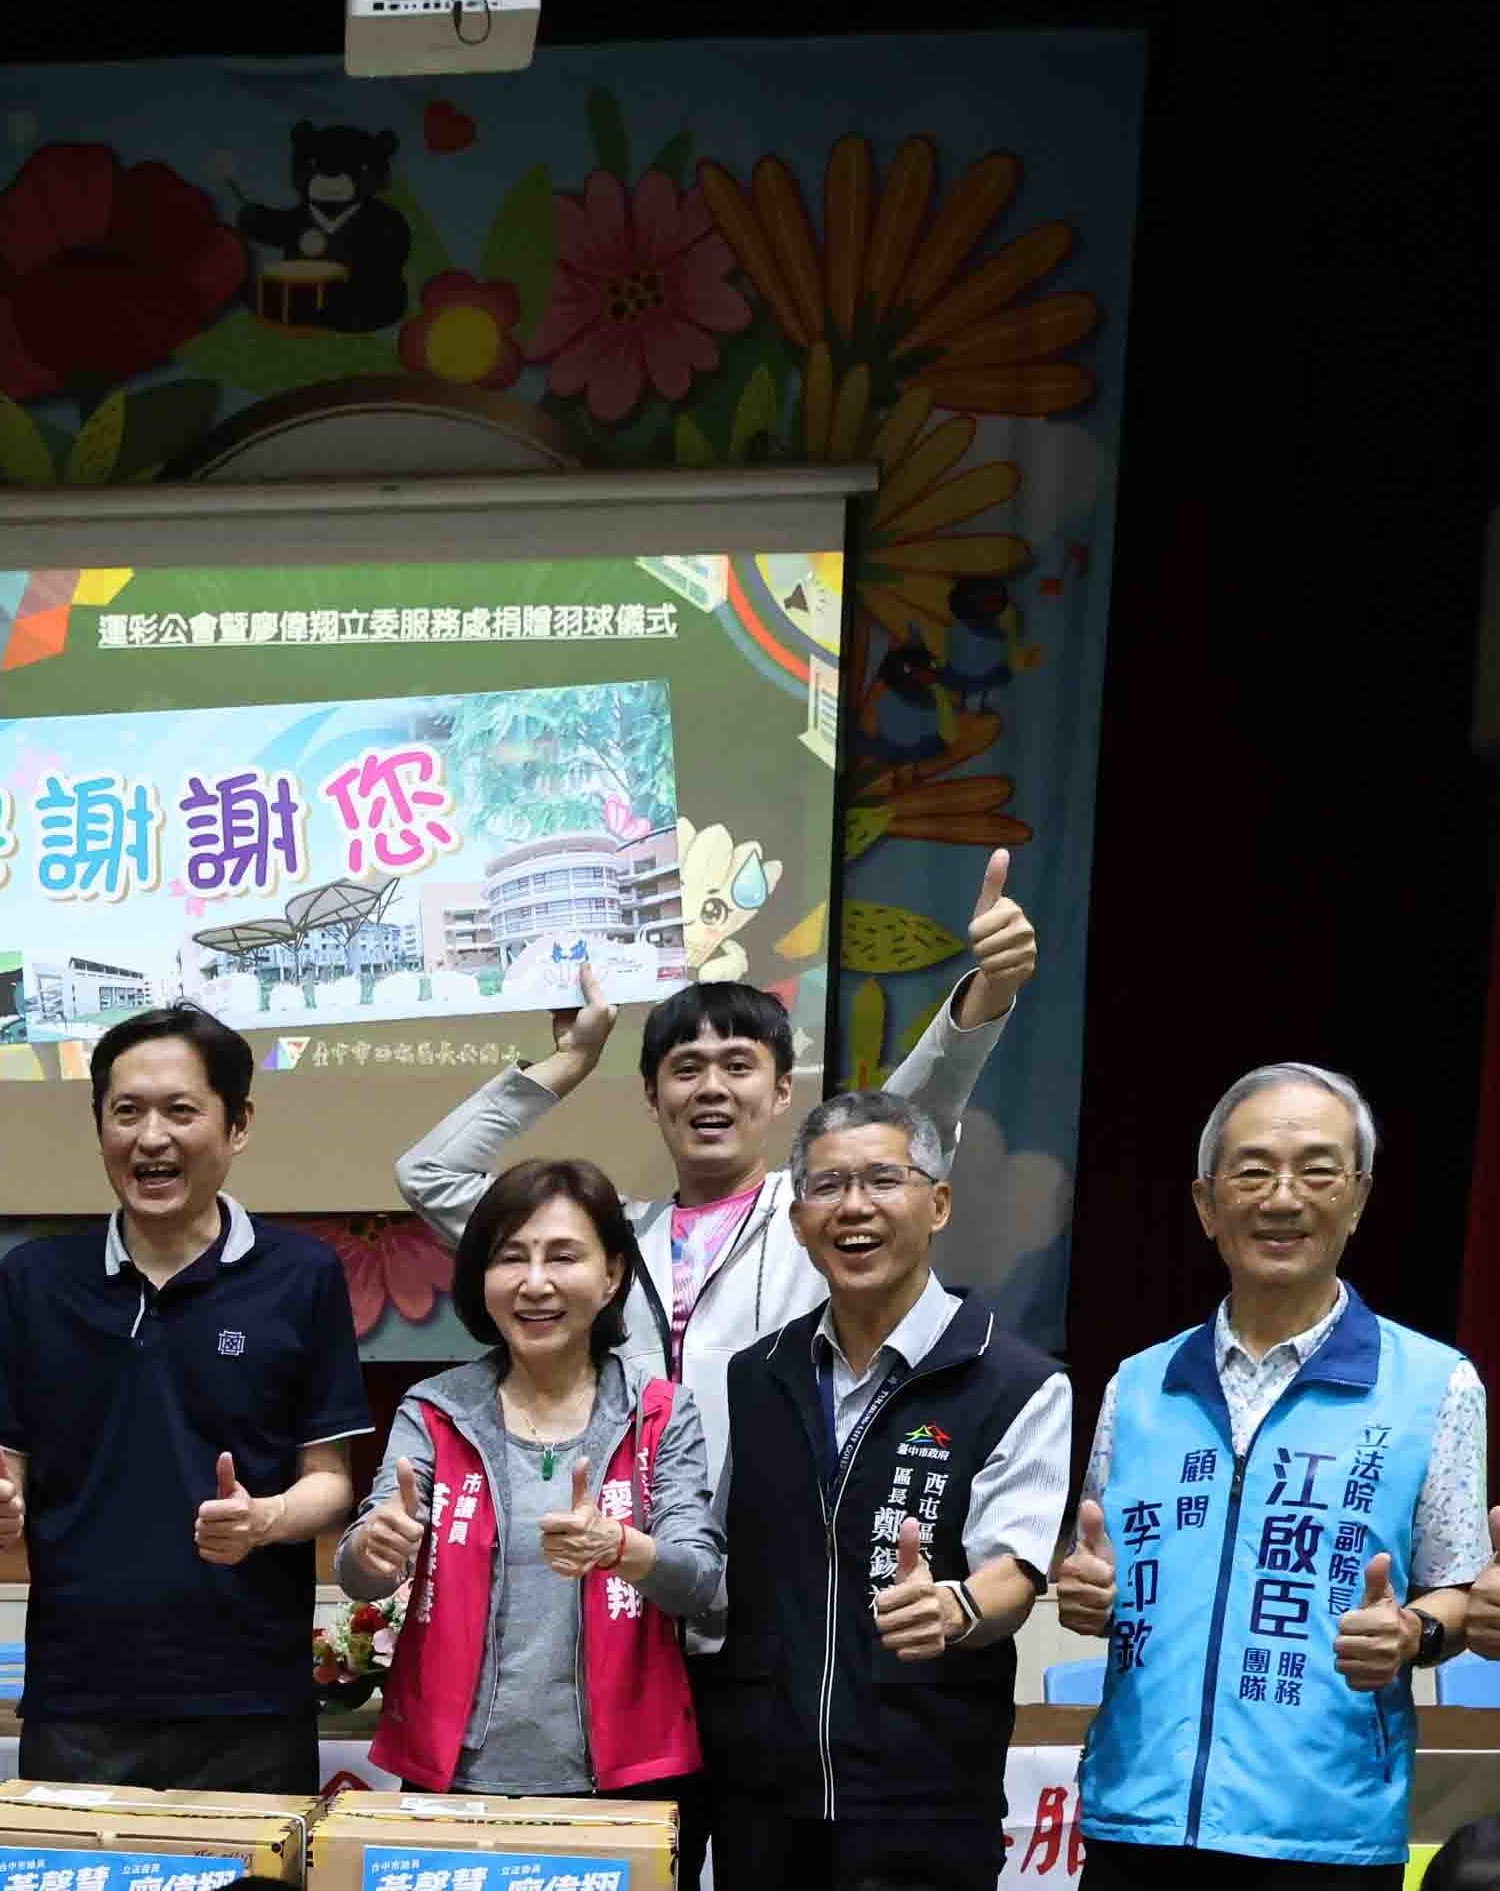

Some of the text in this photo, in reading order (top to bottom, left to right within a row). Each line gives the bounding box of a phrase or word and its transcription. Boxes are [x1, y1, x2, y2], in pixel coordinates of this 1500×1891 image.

[447, 1472, 484, 1546] 市議員
[1176, 1447, 1217, 1531] 顧問
[1327, 1424, 1392, 1617] 立法院 副院長
[601, 1479, 645, 1620] 廖翔
[868, 1467, 914, 1620] 區長 鄭錫
[1239, 1647, 1271, 1702] 團隊
[1274, 1651, 1307, 1707] 服務
